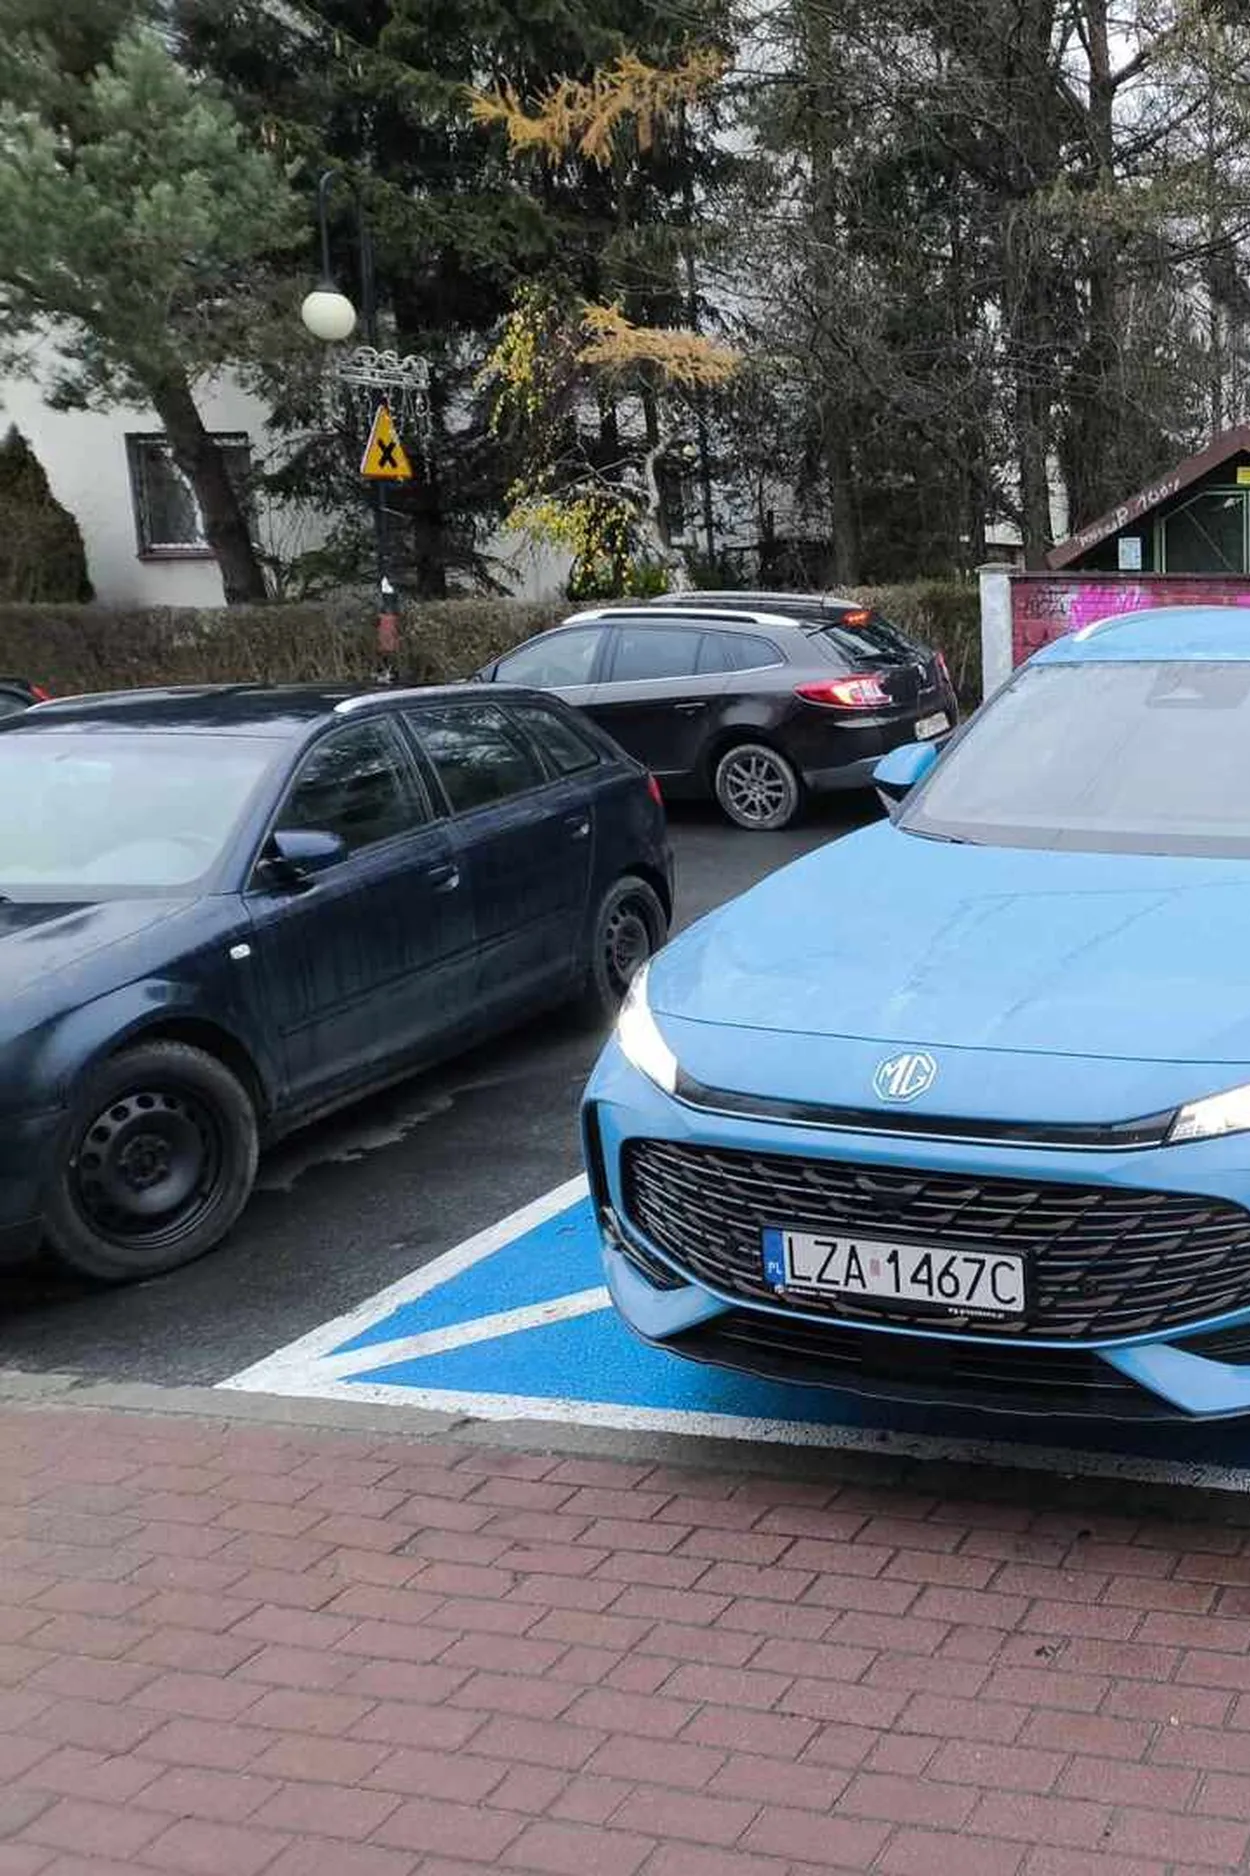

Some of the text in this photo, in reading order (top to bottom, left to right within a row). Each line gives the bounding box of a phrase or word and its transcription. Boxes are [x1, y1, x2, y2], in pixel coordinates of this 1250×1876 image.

[877, 1054, 933, 1099] MG
[768, 1261, 782, 1275] PL
[788, 1236, 1017, 1305] LZA 1467C
